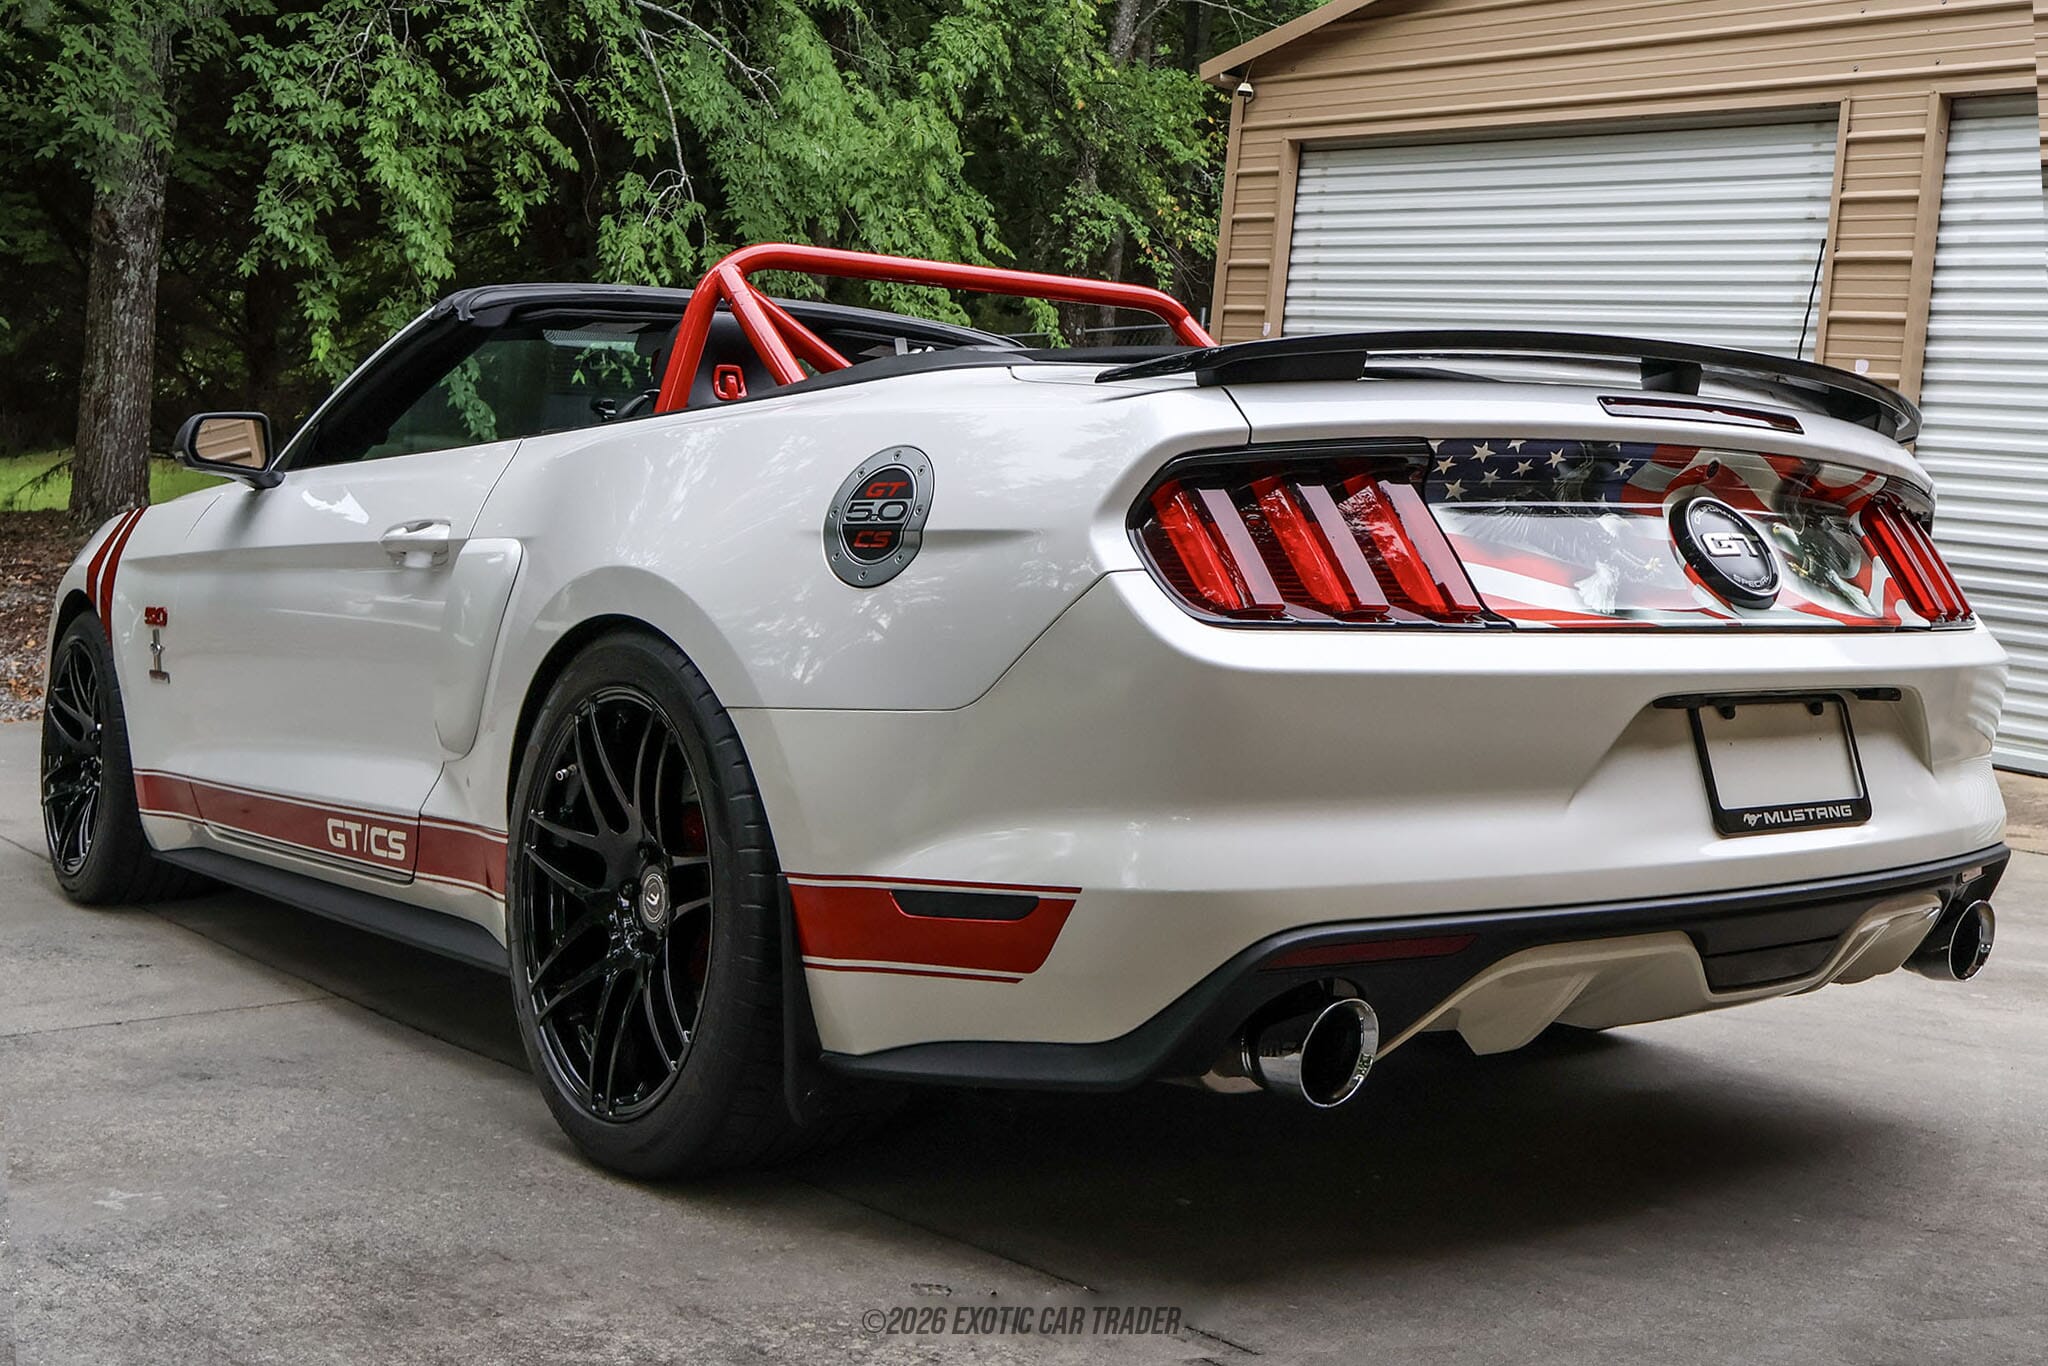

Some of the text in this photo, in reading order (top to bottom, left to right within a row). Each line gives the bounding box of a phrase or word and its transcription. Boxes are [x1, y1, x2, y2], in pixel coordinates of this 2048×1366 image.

[866, 481, 907, 497] GT
[845, 501, 908, 521] 5.0
[854, 530, 893, 548] CS
[1701, 532, 1759, 558] GT
[1764, 805, 1853, 825] MUSTANG
